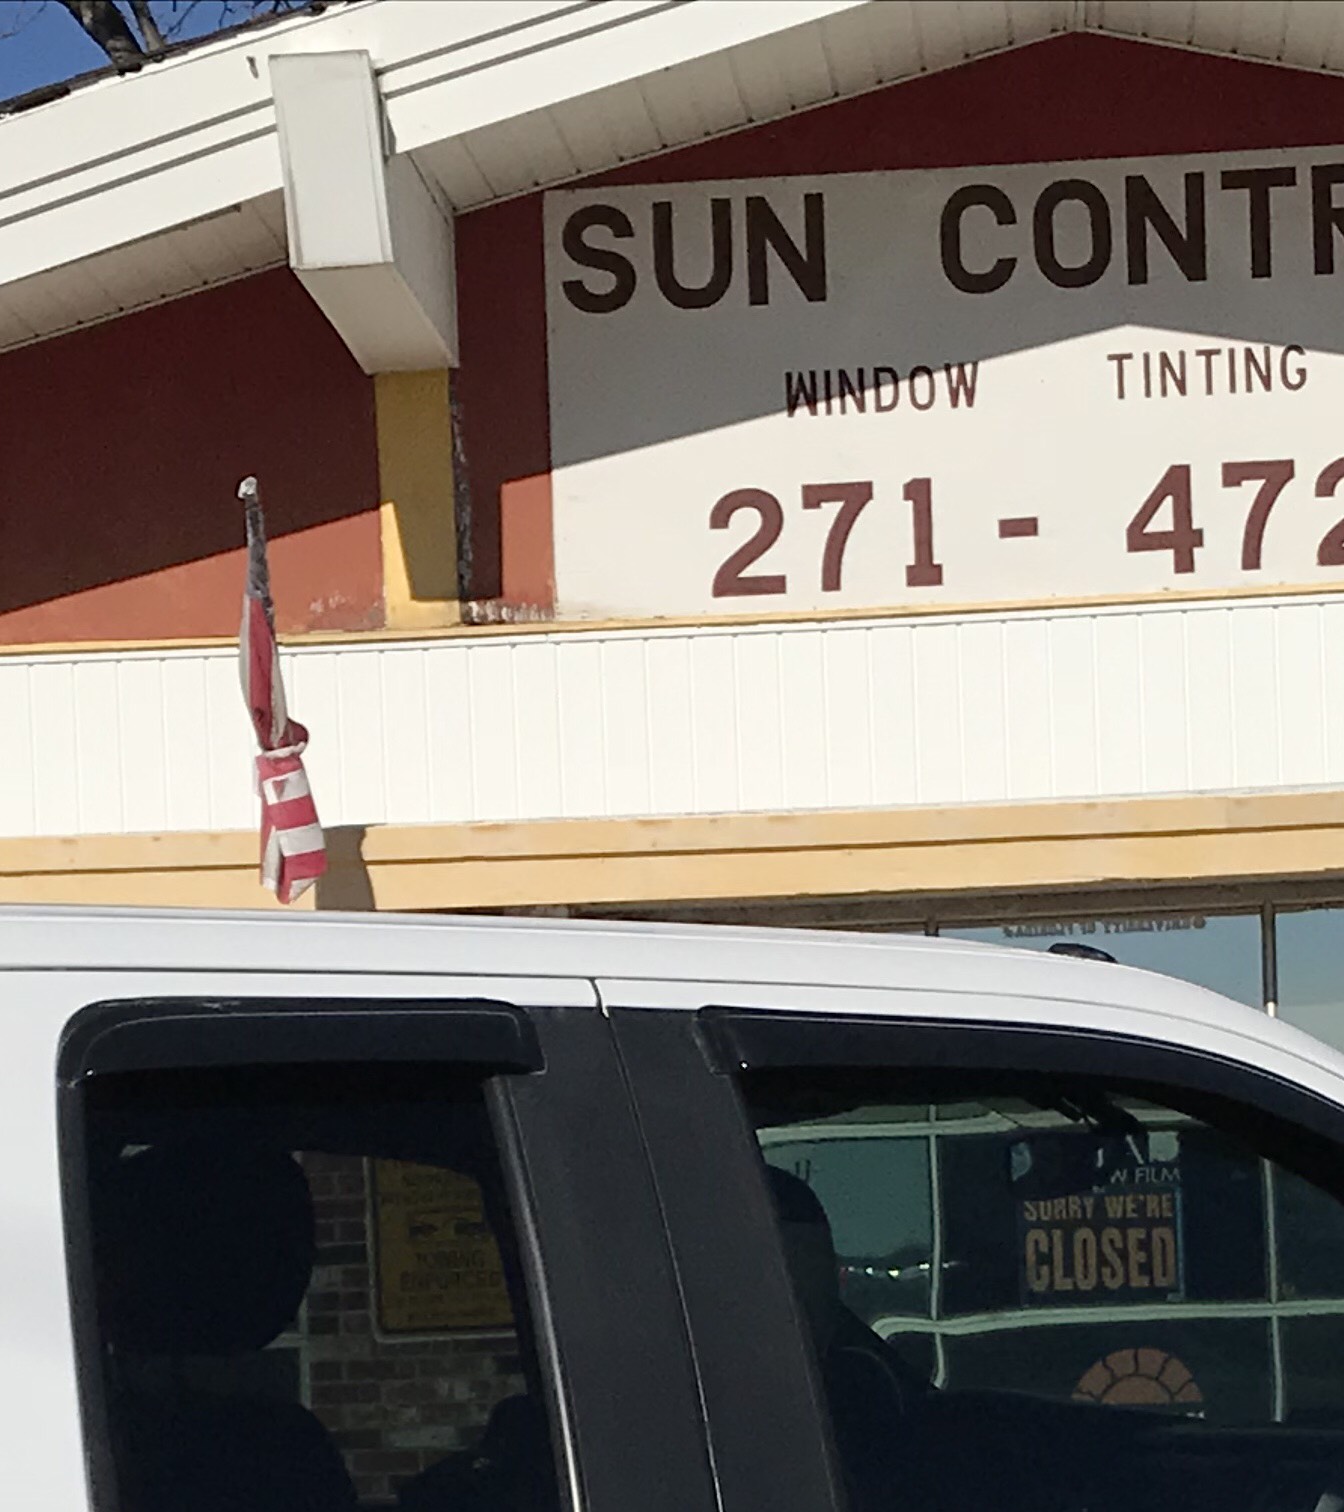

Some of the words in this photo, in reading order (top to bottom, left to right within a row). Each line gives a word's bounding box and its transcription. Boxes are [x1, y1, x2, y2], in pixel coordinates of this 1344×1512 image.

[561, 192, 828, 314] SUN
[783, 361, 980, 419] WINDOW
[1106, 344, 1309, 400] TINTING
[1023, 1195, 1096, 1221] SORRY
[1105, 1193, 1174, 1219] WE'RE
[1134, 1166, 1182, 1185] FILM
[1025, 1226, 1176, 1292] CLOSED
